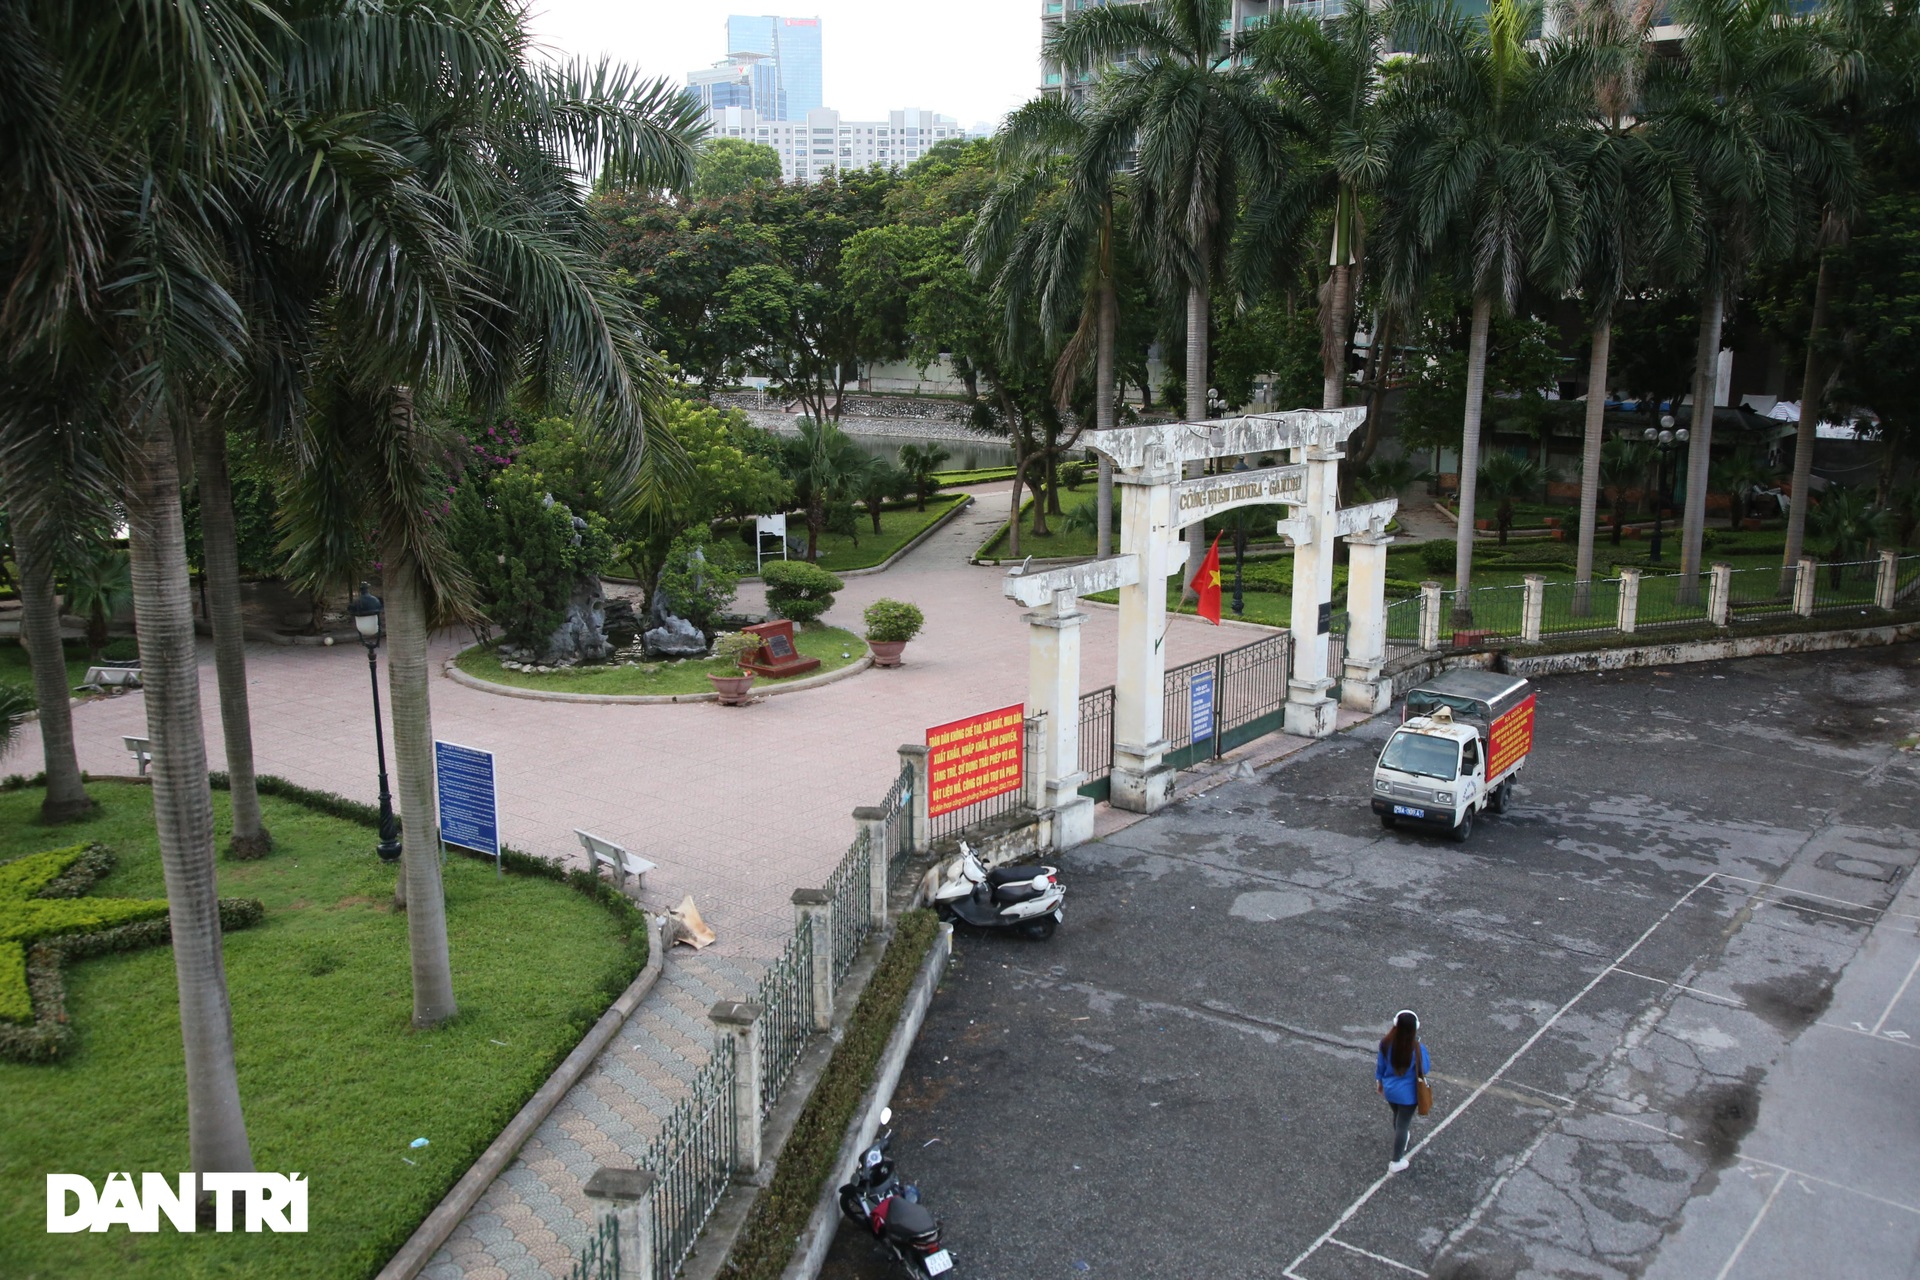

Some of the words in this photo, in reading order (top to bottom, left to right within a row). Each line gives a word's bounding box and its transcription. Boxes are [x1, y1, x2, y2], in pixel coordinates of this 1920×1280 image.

[1180, 488, 1206, 510] CÔNG
[1207, 484, 1230, 505] VIÊN
[1231, 482, 1263, 501] INDIRA
[1269, 476, 1302, 495] GANDHI
